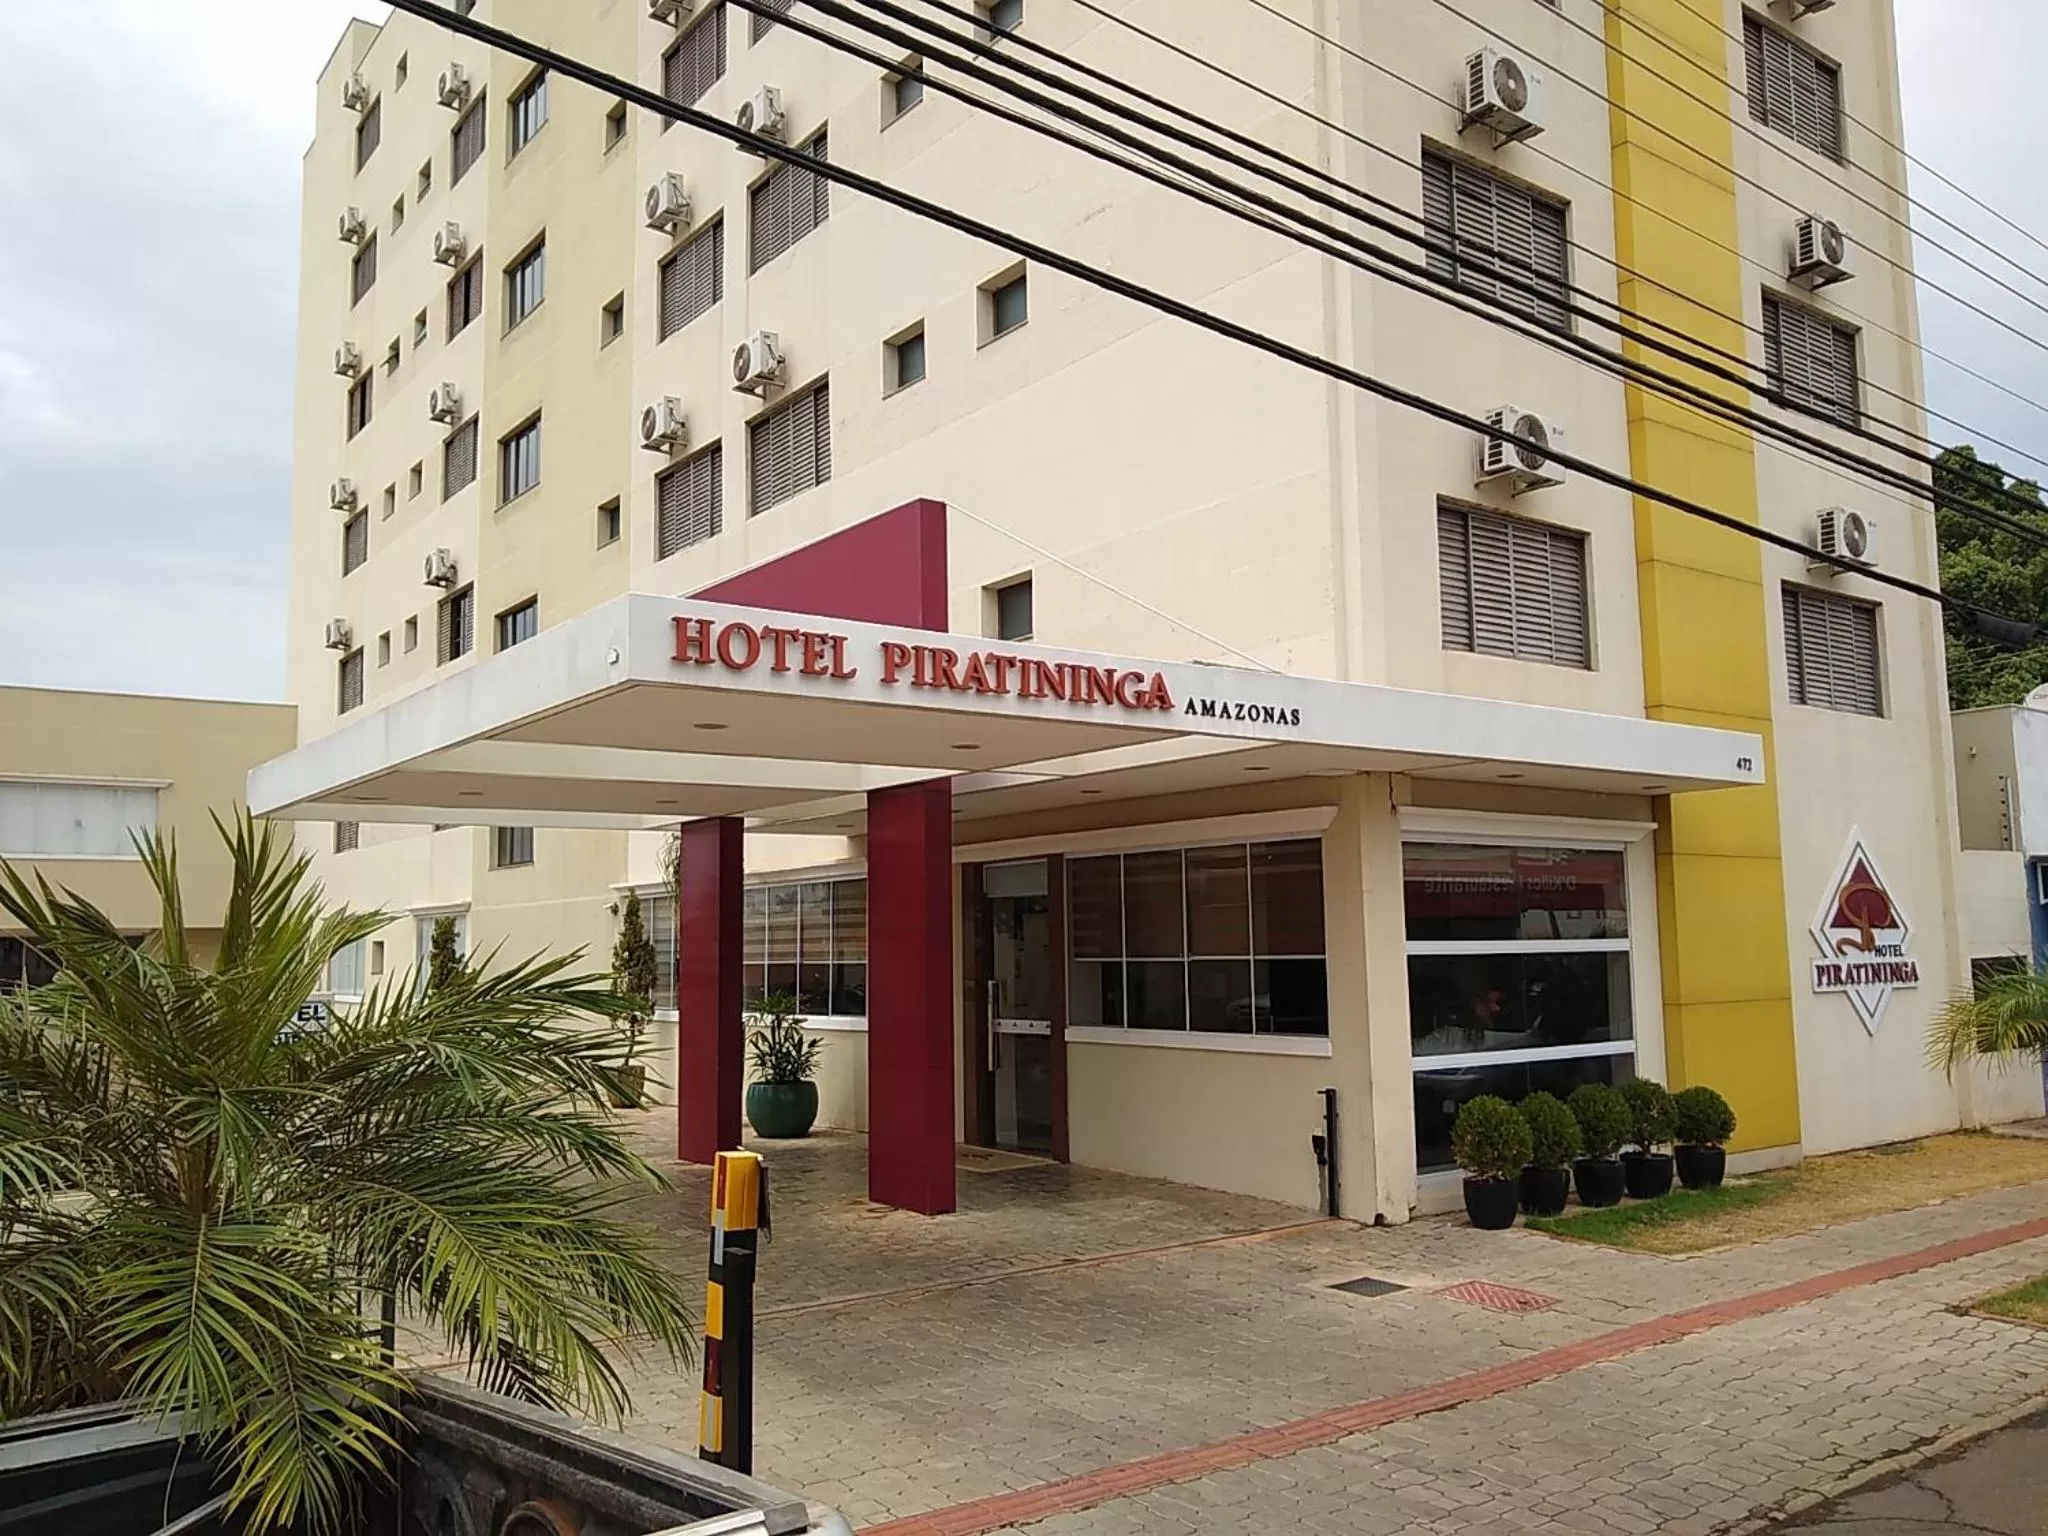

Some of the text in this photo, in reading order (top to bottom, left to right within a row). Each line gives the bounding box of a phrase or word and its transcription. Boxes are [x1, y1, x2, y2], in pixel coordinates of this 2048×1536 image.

[671, 615, 1301, 726] HOTEL PIRATININGA AMAZONAS
[1736, 757, 1753, 772] 472
[1874, 944, 1905, 958] HOTEL
[1815, 961, 1920, 987] PIRATININGA
